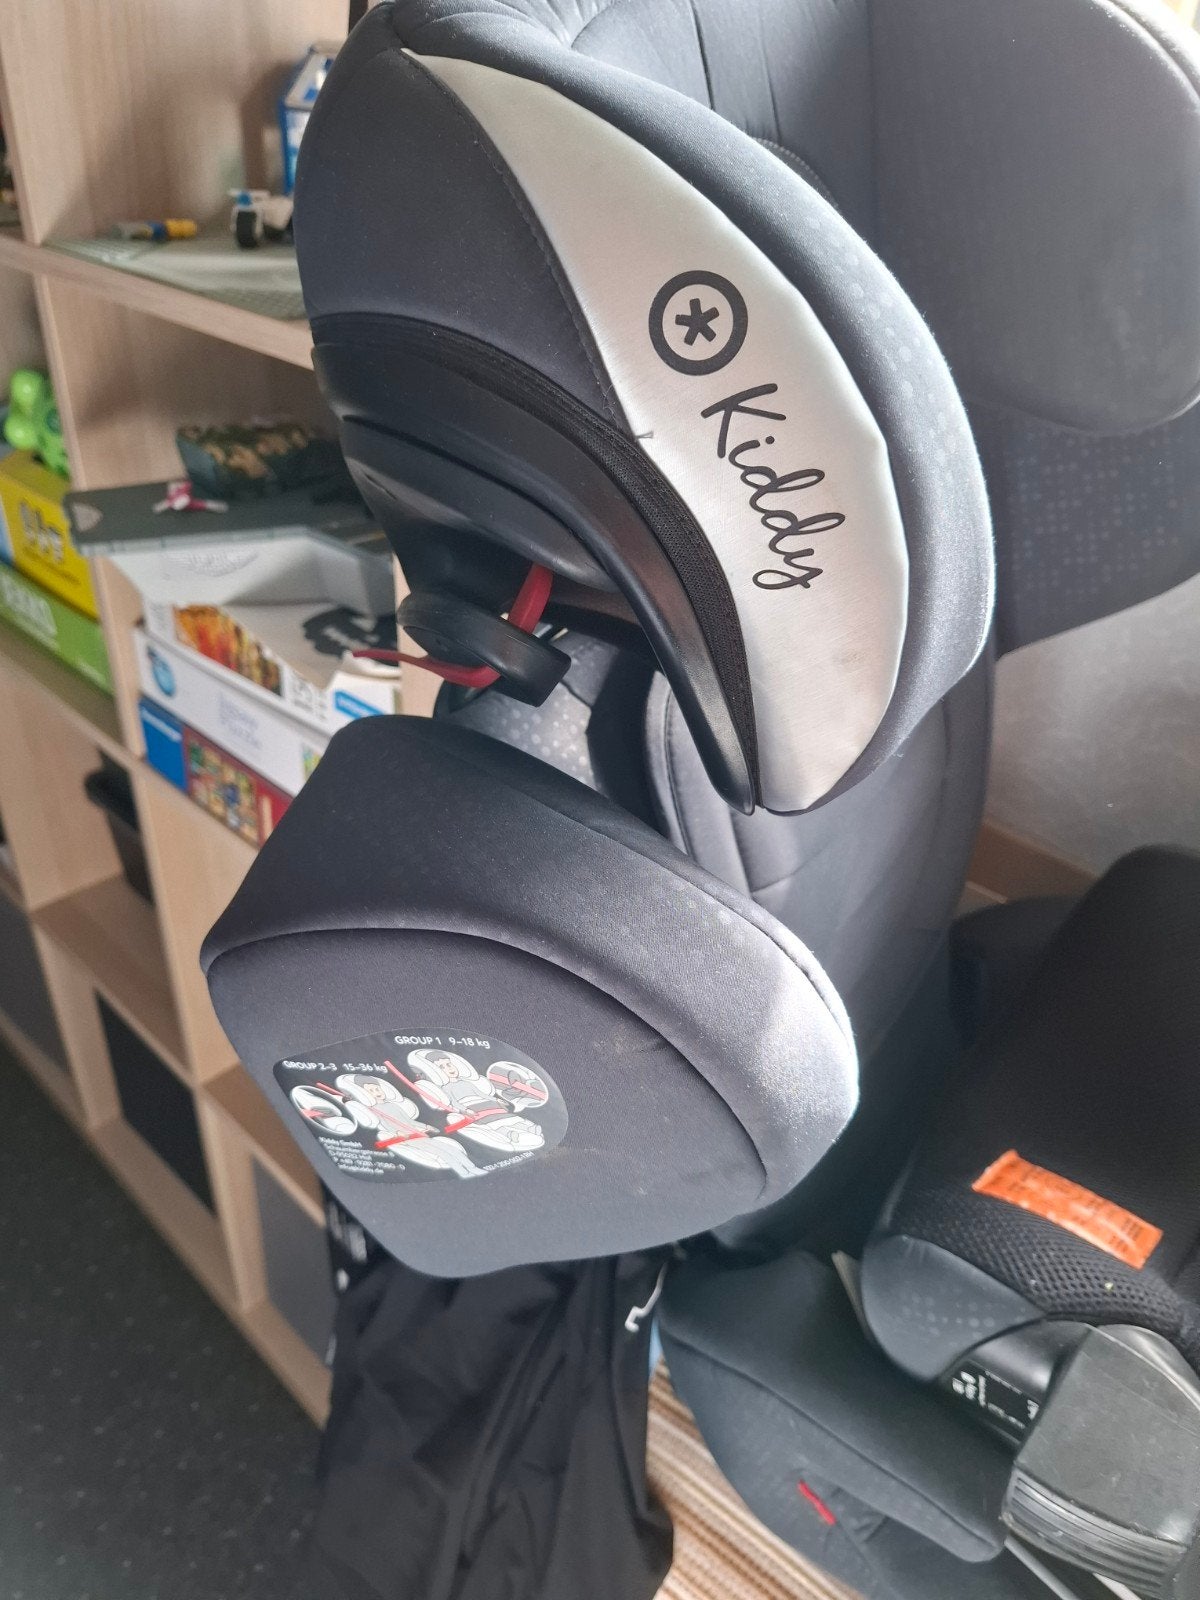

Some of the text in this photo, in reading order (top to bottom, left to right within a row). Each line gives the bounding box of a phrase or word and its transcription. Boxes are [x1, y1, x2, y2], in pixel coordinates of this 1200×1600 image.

[700, 382, 846, 590] Kiddy
[394, 1035, 433, 1045] GROUP
[435, 1037, 442, 1045] 1
[475, 1038, 491, 1049] kg
[282, 1060, 316, 1070] GROUP
[374, 1063, 389, 1074] kg
